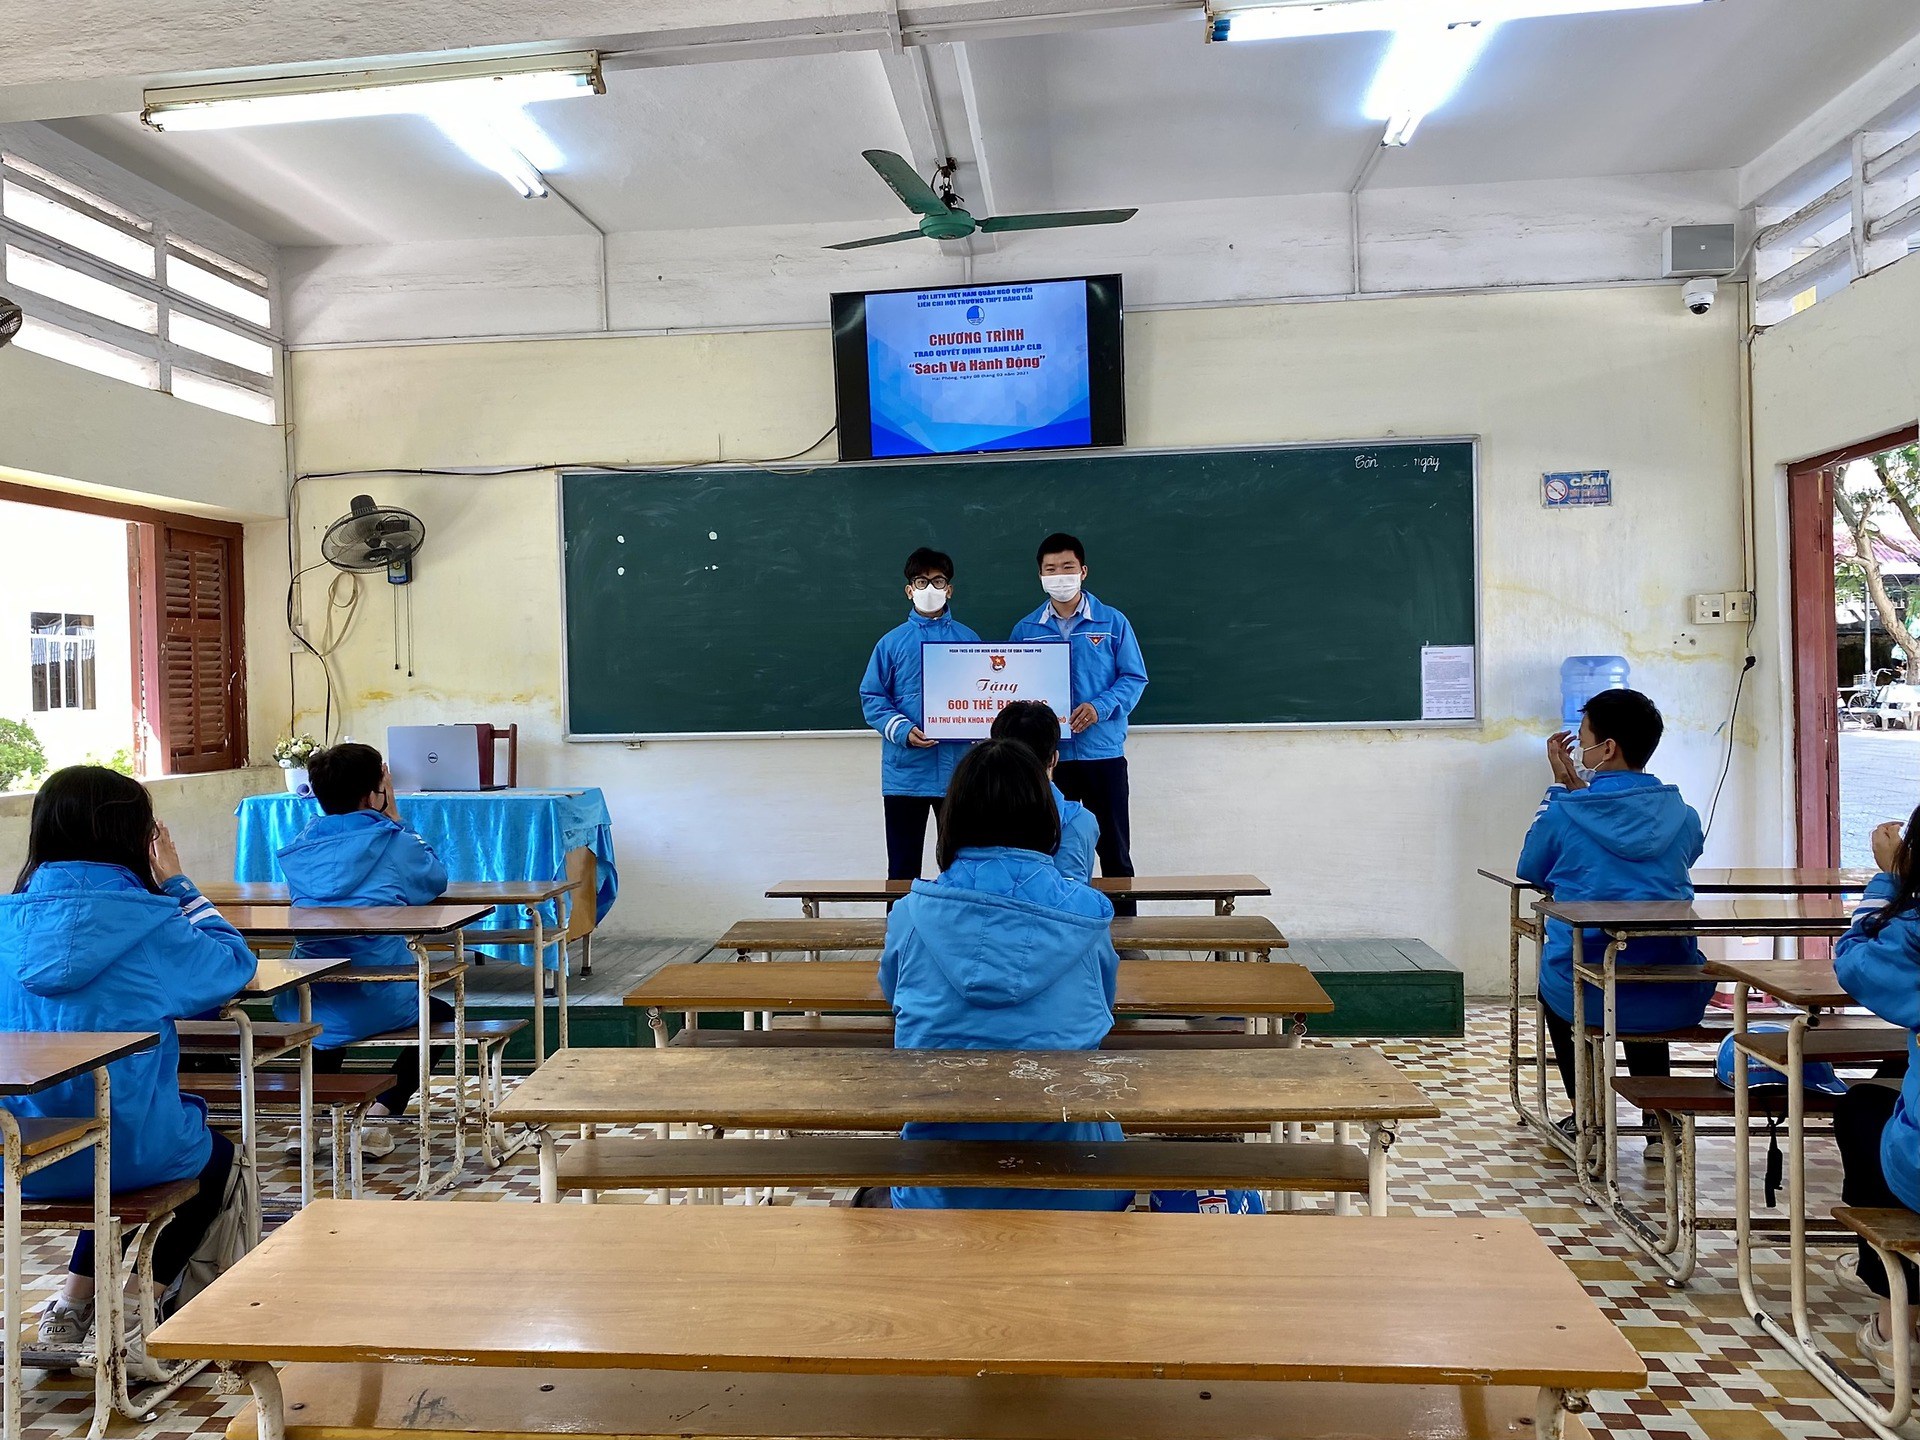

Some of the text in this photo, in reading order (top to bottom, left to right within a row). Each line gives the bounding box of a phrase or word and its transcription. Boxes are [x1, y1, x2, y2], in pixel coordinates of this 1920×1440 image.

[929, 328, 1024, 346] CHƯƠNG TRÌNH
[950, 360, 966, 372] Và
[970, 358, 1002, 371] Hành
[976, 679, 1018, 694] Tặng
[948, 700, 968, 710] 600
[972, 696, 993, 710] THẺ
[46, 1326, 66, 1334] FILA
